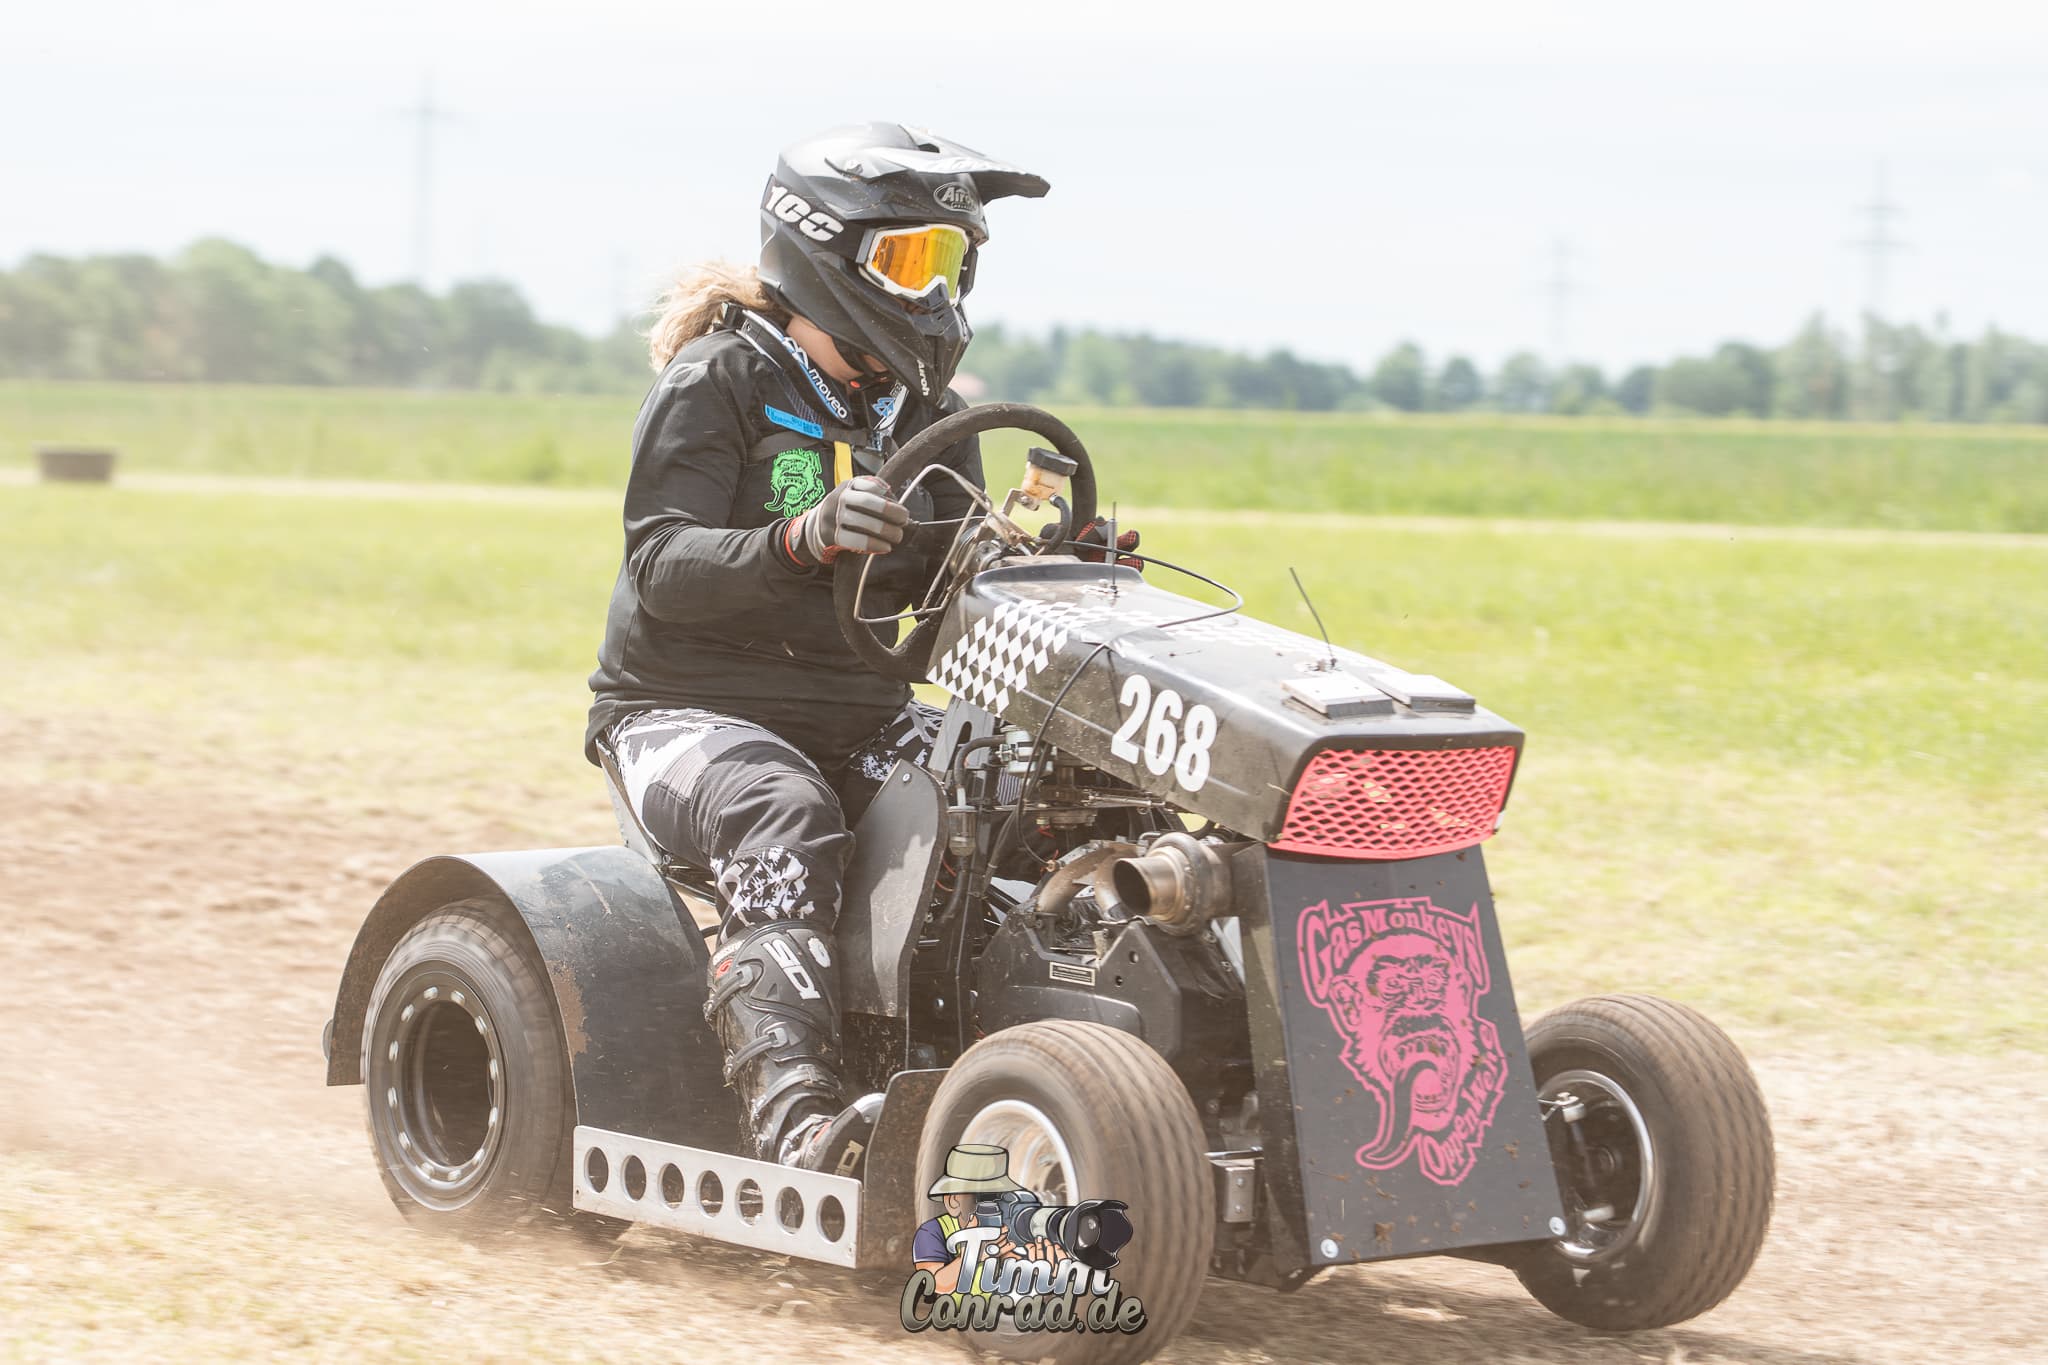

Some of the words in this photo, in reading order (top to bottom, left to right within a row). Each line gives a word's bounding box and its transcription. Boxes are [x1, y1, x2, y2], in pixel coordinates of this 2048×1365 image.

[809, 368, 848, 419] moveo
[1111, 674, 1217, 792] 268
[1306, 913, 1362, 999] Gas
